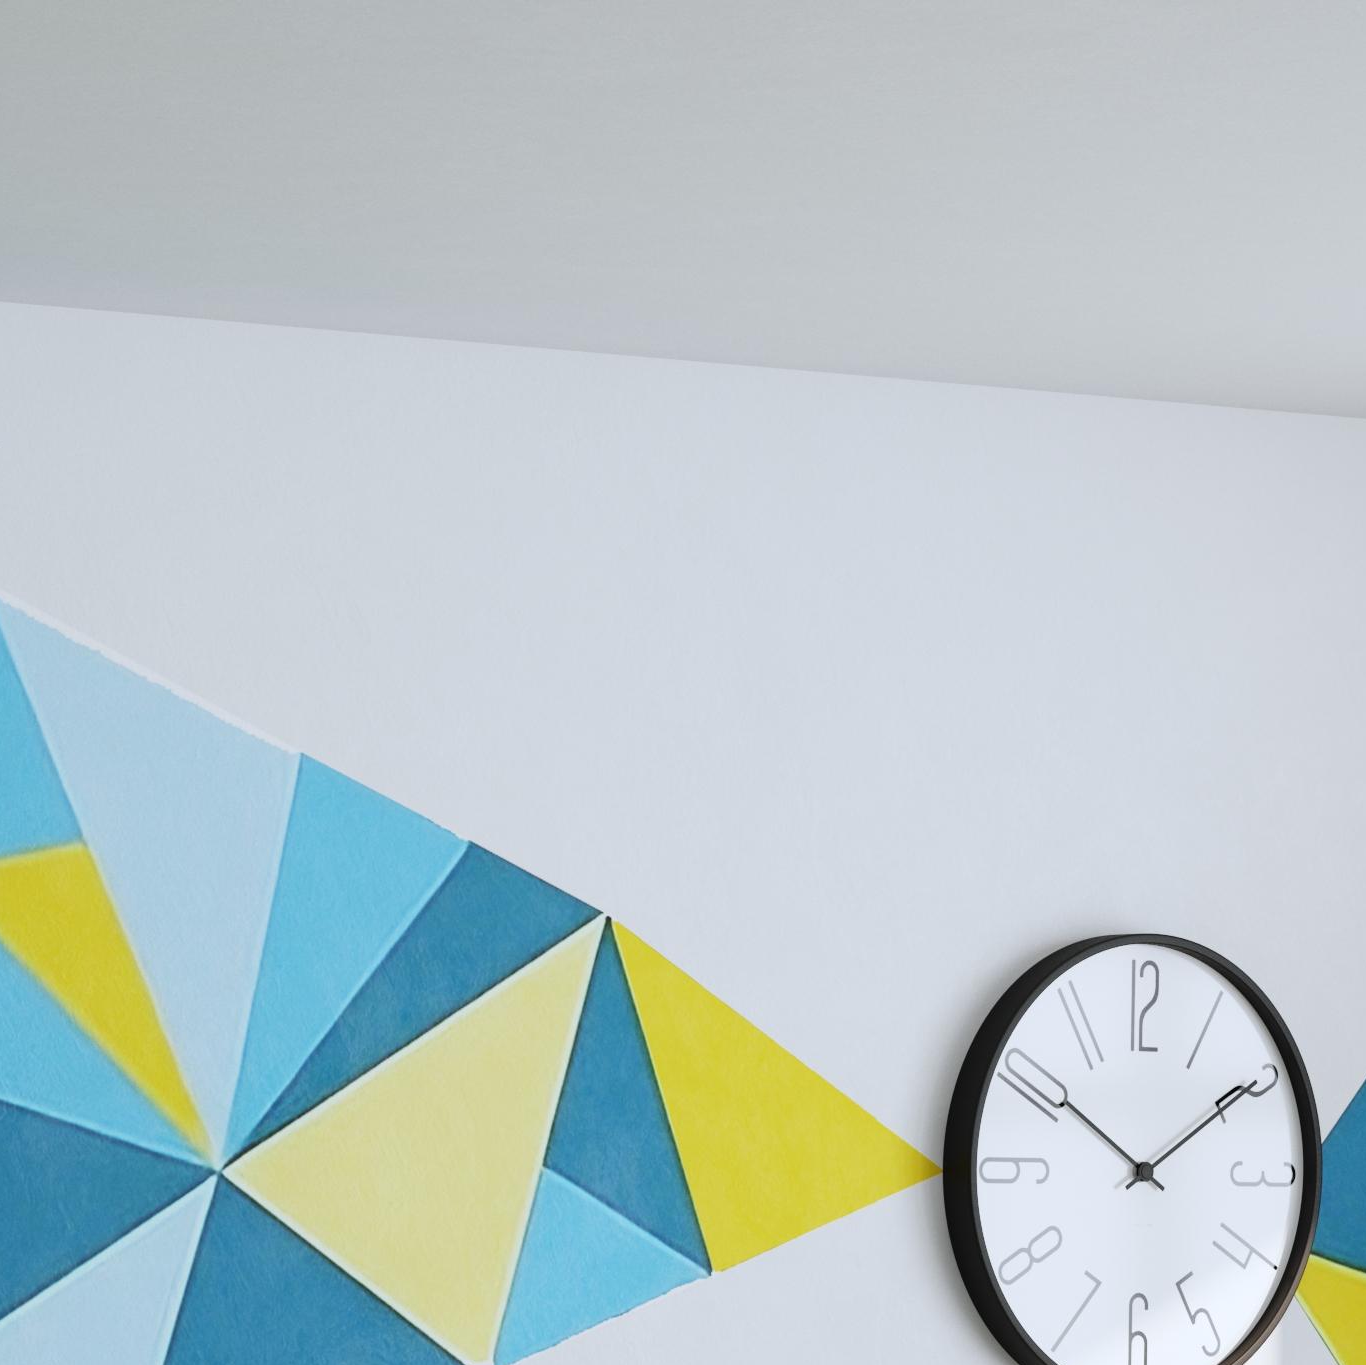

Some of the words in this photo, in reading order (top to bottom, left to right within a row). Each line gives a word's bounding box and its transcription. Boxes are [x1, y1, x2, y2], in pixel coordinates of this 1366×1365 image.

[1057, 980, 1105, 1071] 11
[1131, 959, 1160, 1052] 12
[1186, 990, 1224, 1070] 1
[997, 1047, 1068, 1122] 10
[978, 1156, 1050, 1184] 9
[1230, 1160, 1296, 1188] 3
[997, 1225, 1063, 1286] 8
[1212, 1222, 1278, 1270] 4
[1051, 1270, 1102, 1352] 7
[1176, 1271, 1221, 1357] 5
